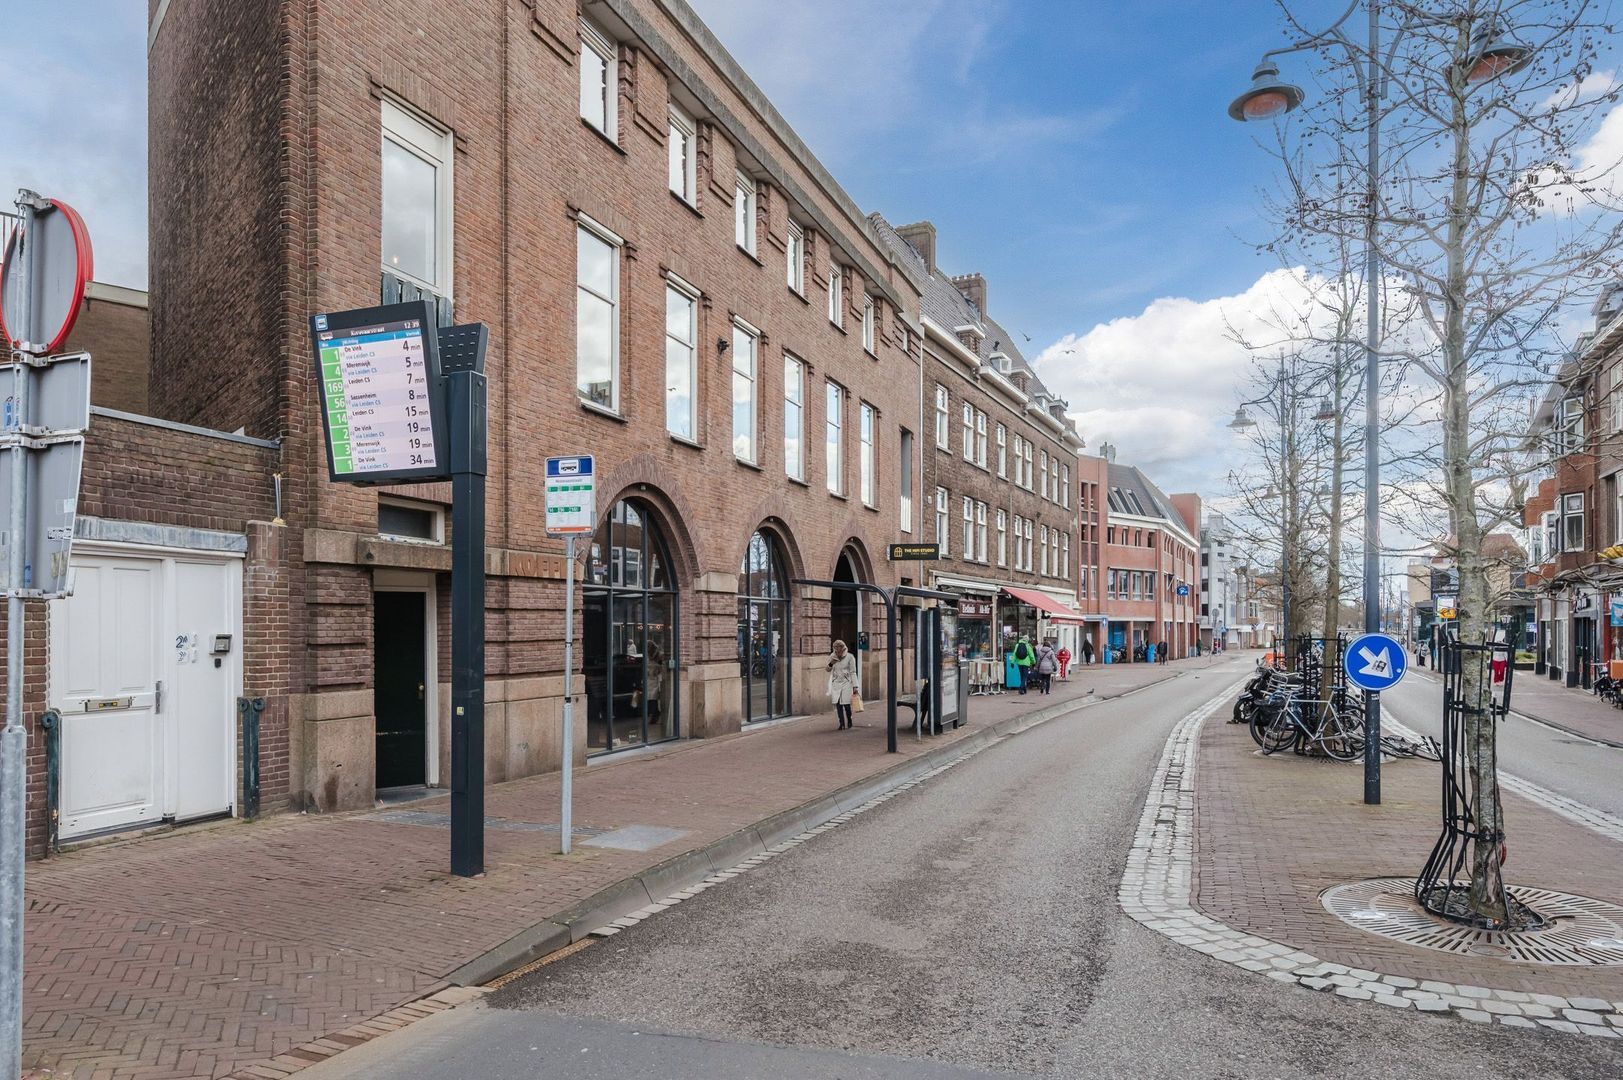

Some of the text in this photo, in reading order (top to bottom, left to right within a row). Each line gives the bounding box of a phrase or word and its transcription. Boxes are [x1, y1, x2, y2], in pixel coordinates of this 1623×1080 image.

[403, 340, 409, 351] 4
[334, 350, 339, 360] 1
[406, 357, 411, 367] 5
[335, 366, 340, 376] 4
[407, 373, 412, 384] 7
[327, 381, 342, 392] 169
[409, 390, 415, 400] 8
[334, 398, 345, 408] 56
[406, 406, 417, 417] 15
[337, 414, 347, 423] 14
[407, 422, 419, 433] 19
[343, 429, 349, 439] 2
[409, 439, 420, 448] 19
[345, 445, 351, 455] 3
[410, 455, 422, 465] 34
[348, 461, 353, 470] 1
